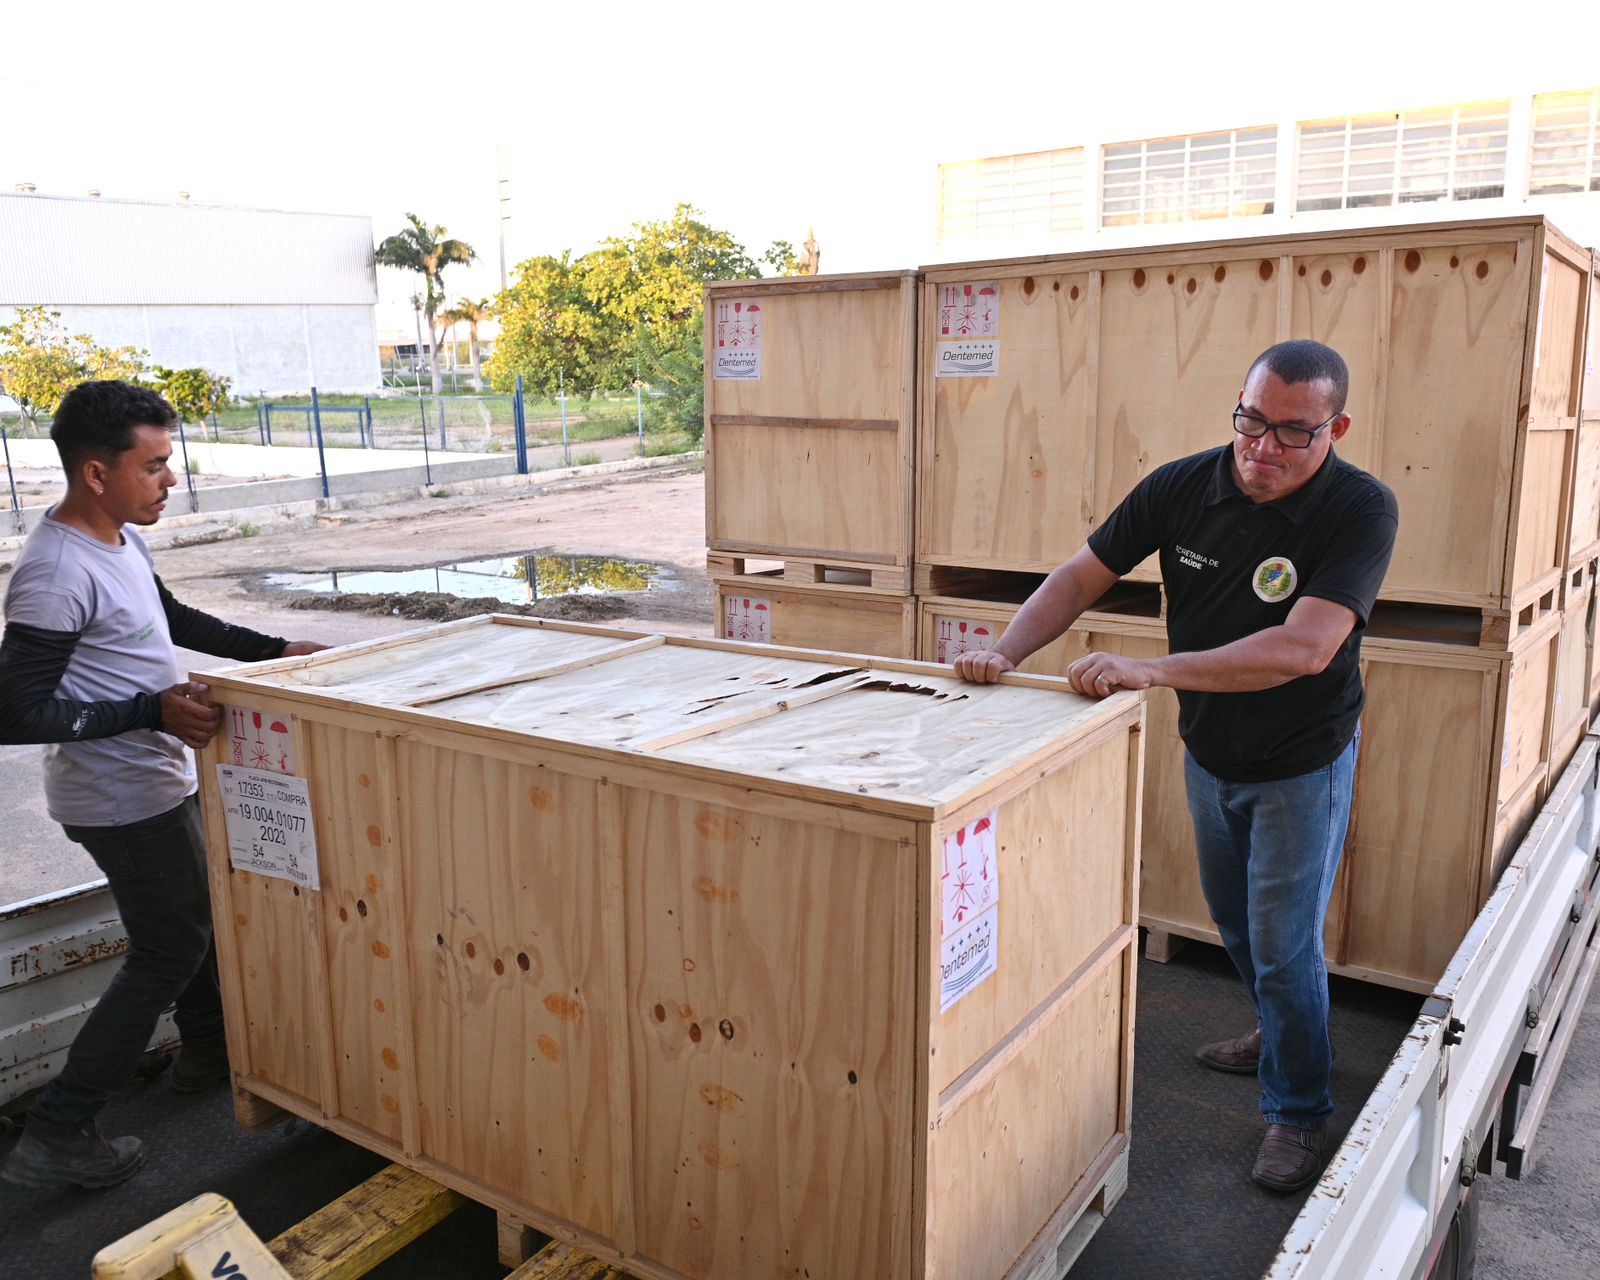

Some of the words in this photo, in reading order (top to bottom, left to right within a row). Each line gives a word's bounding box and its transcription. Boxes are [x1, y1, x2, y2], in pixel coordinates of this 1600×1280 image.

[718, 357, 757, 367] Dentemed
[943, 350, 994, 361] Dentemed
[1179, 555, 1203, 570] SAÚDE
[1208, 558, 1220, 568] DE
[238, 781, 264, 798] 17353
[276, 790, 308, 807] COMPRA
[239, 803, 306, 832] 19.004.01077
[260, 825, 287, 846] 2023
[253, 844, 265, 858] 54
[288, 854, 298, 869] 54
